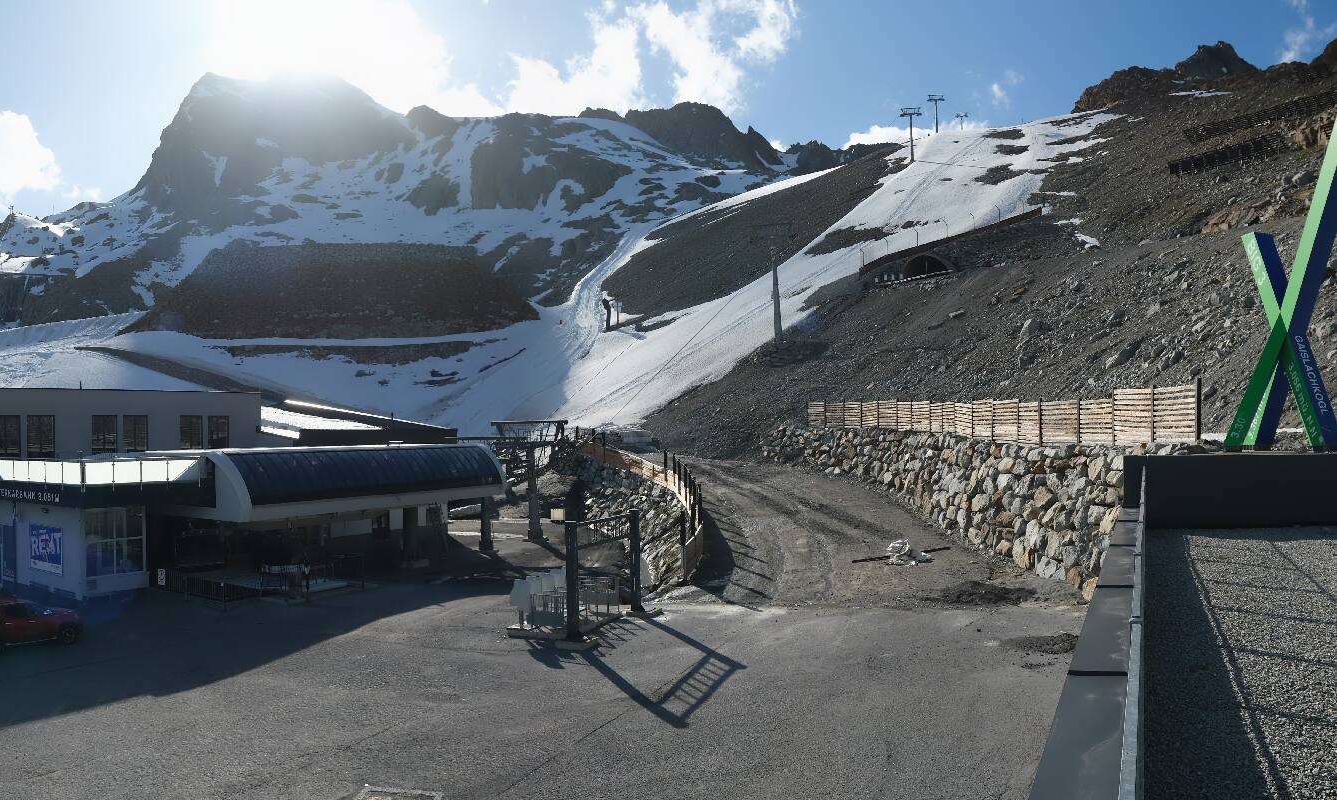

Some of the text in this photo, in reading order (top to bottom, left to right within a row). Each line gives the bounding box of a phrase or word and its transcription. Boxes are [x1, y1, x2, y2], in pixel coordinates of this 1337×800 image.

[1246, 237, 1267, 286] BIG 3
[1294, 334, 1330, 416] GAISLACHKOGL
